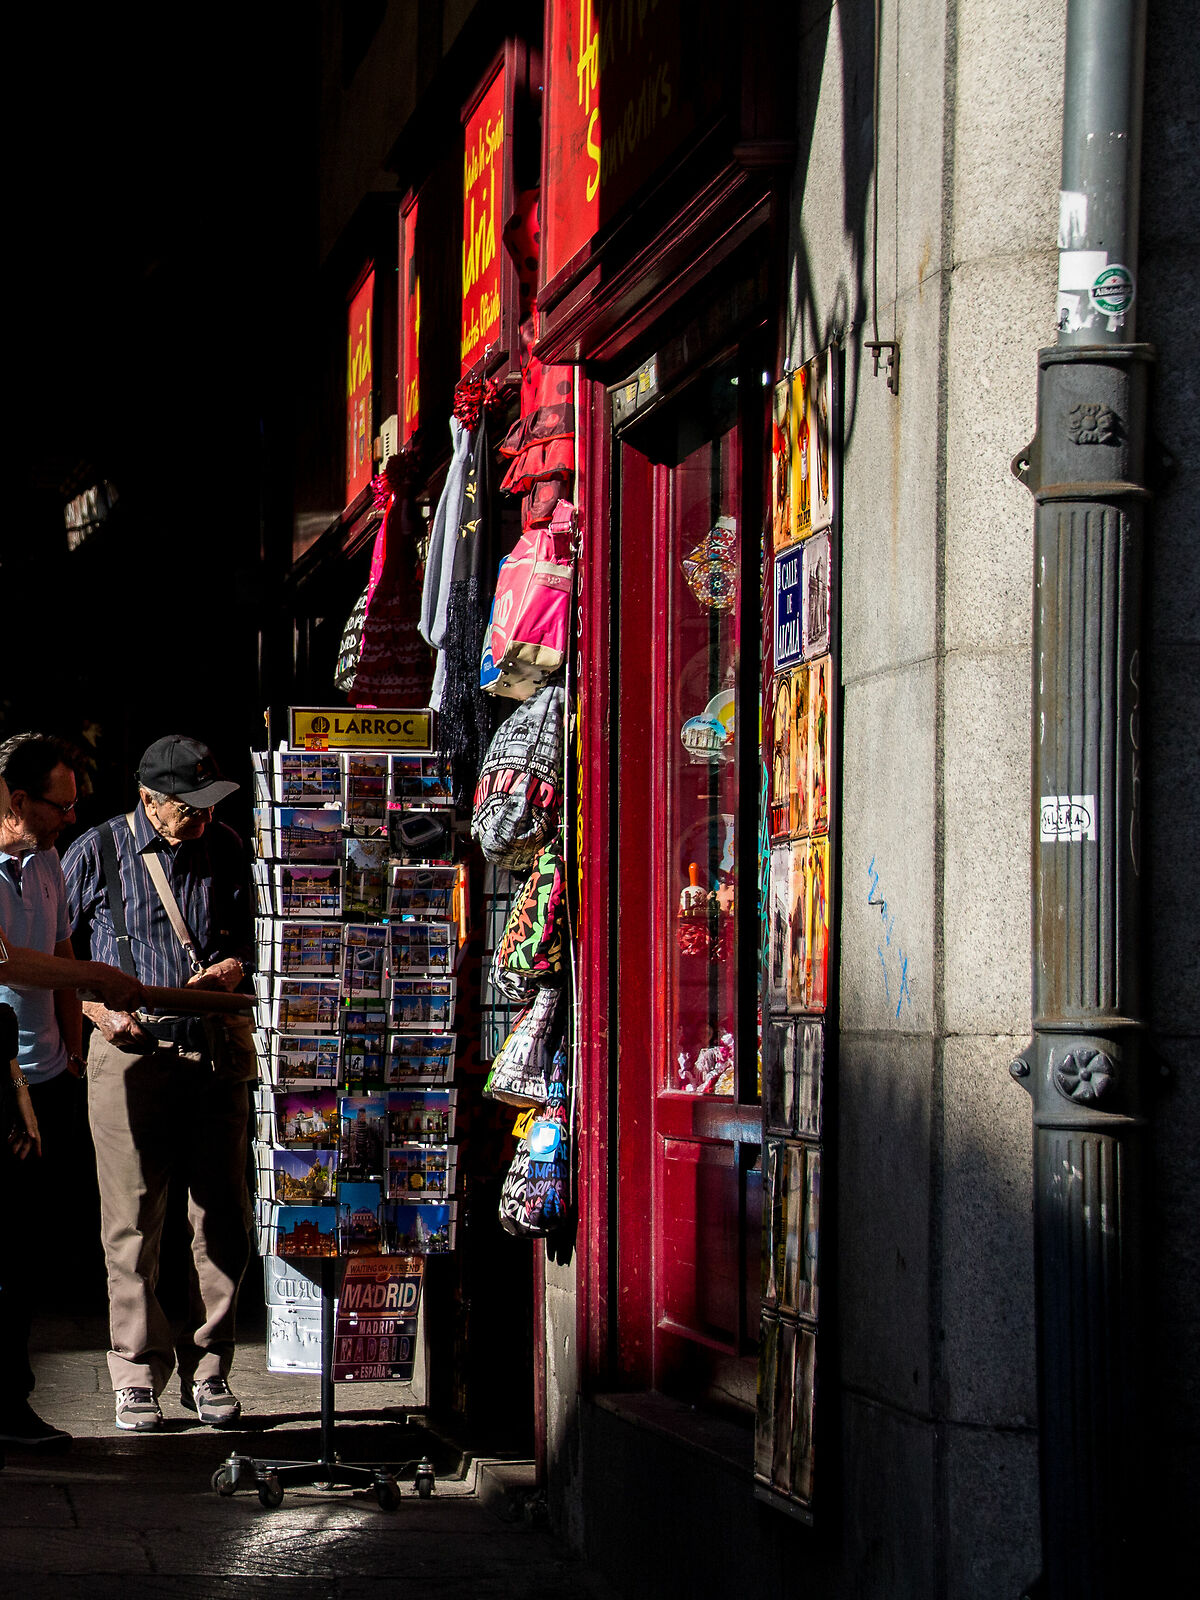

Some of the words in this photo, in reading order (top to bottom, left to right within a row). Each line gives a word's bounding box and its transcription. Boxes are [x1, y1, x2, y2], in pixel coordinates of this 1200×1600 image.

[781, 558, 798, 590] CALLE
[786, 593, 793, 614] DE
[334, 718, 414, 735] LARROC
[350, 1264, 377, 1273] WAITING
[378, 1264, 387, 1272] ON
[395, 1264, 420, 1272] FRIEND
[343, 1282, 417, 1309] MADRID
[359, 1320, 395, 1335] MADRID
[340, 1337, 410, 1363] MADRID
[360, 1364, 386, 1379] ESPAÑA
